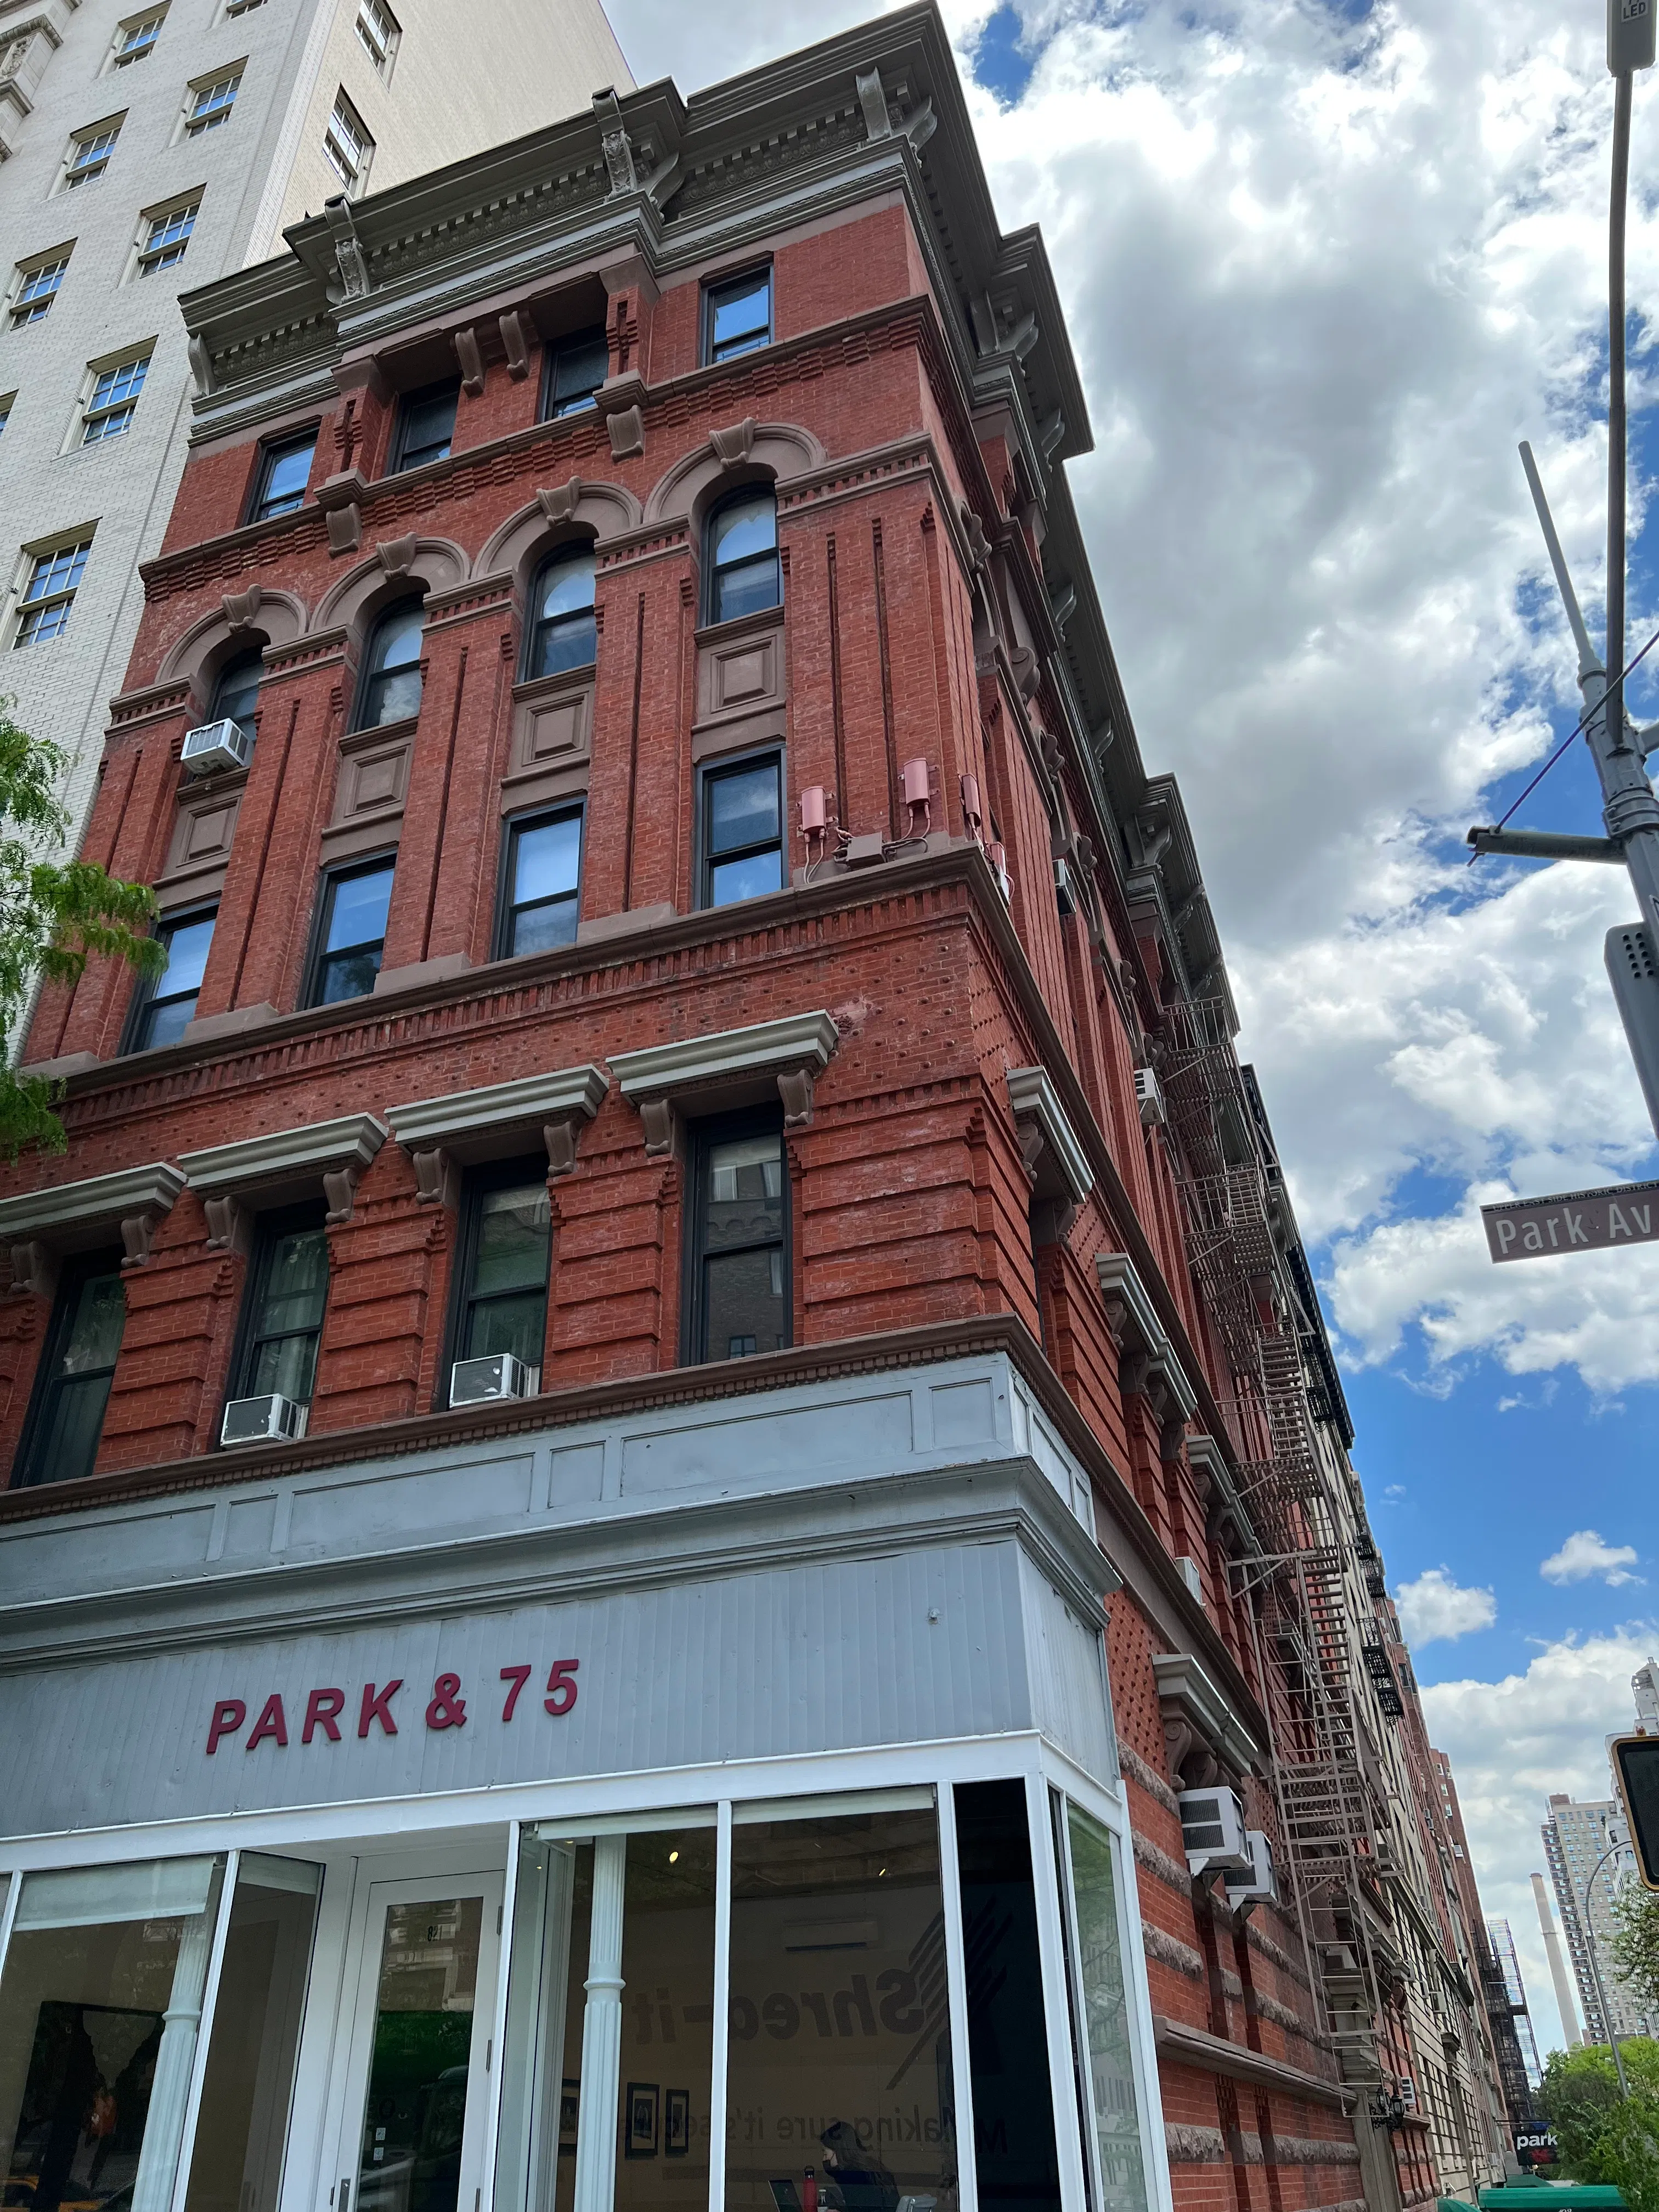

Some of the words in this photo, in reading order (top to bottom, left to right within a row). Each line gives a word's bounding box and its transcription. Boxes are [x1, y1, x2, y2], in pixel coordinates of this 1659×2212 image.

[1623, 2, 1646, 19] LED
[1549, 1194, 1568, 1203] SIDE
[1571, 1187, 1613, 1200] HISTORIC
[1616, 1181, 1658, 1193] DISTRICT
[1495, 1207, 1589, 1255] Park
[1609, 1203, 1651, 1239] Av
[206, 1679, 404, 1754] PARK
[425, 1672, 467, 1729] &
[500, 1658, 580, 1722] 75
[428, 1925, 443, 1942] 821
[1517, 2132, 1558, 2150] park
